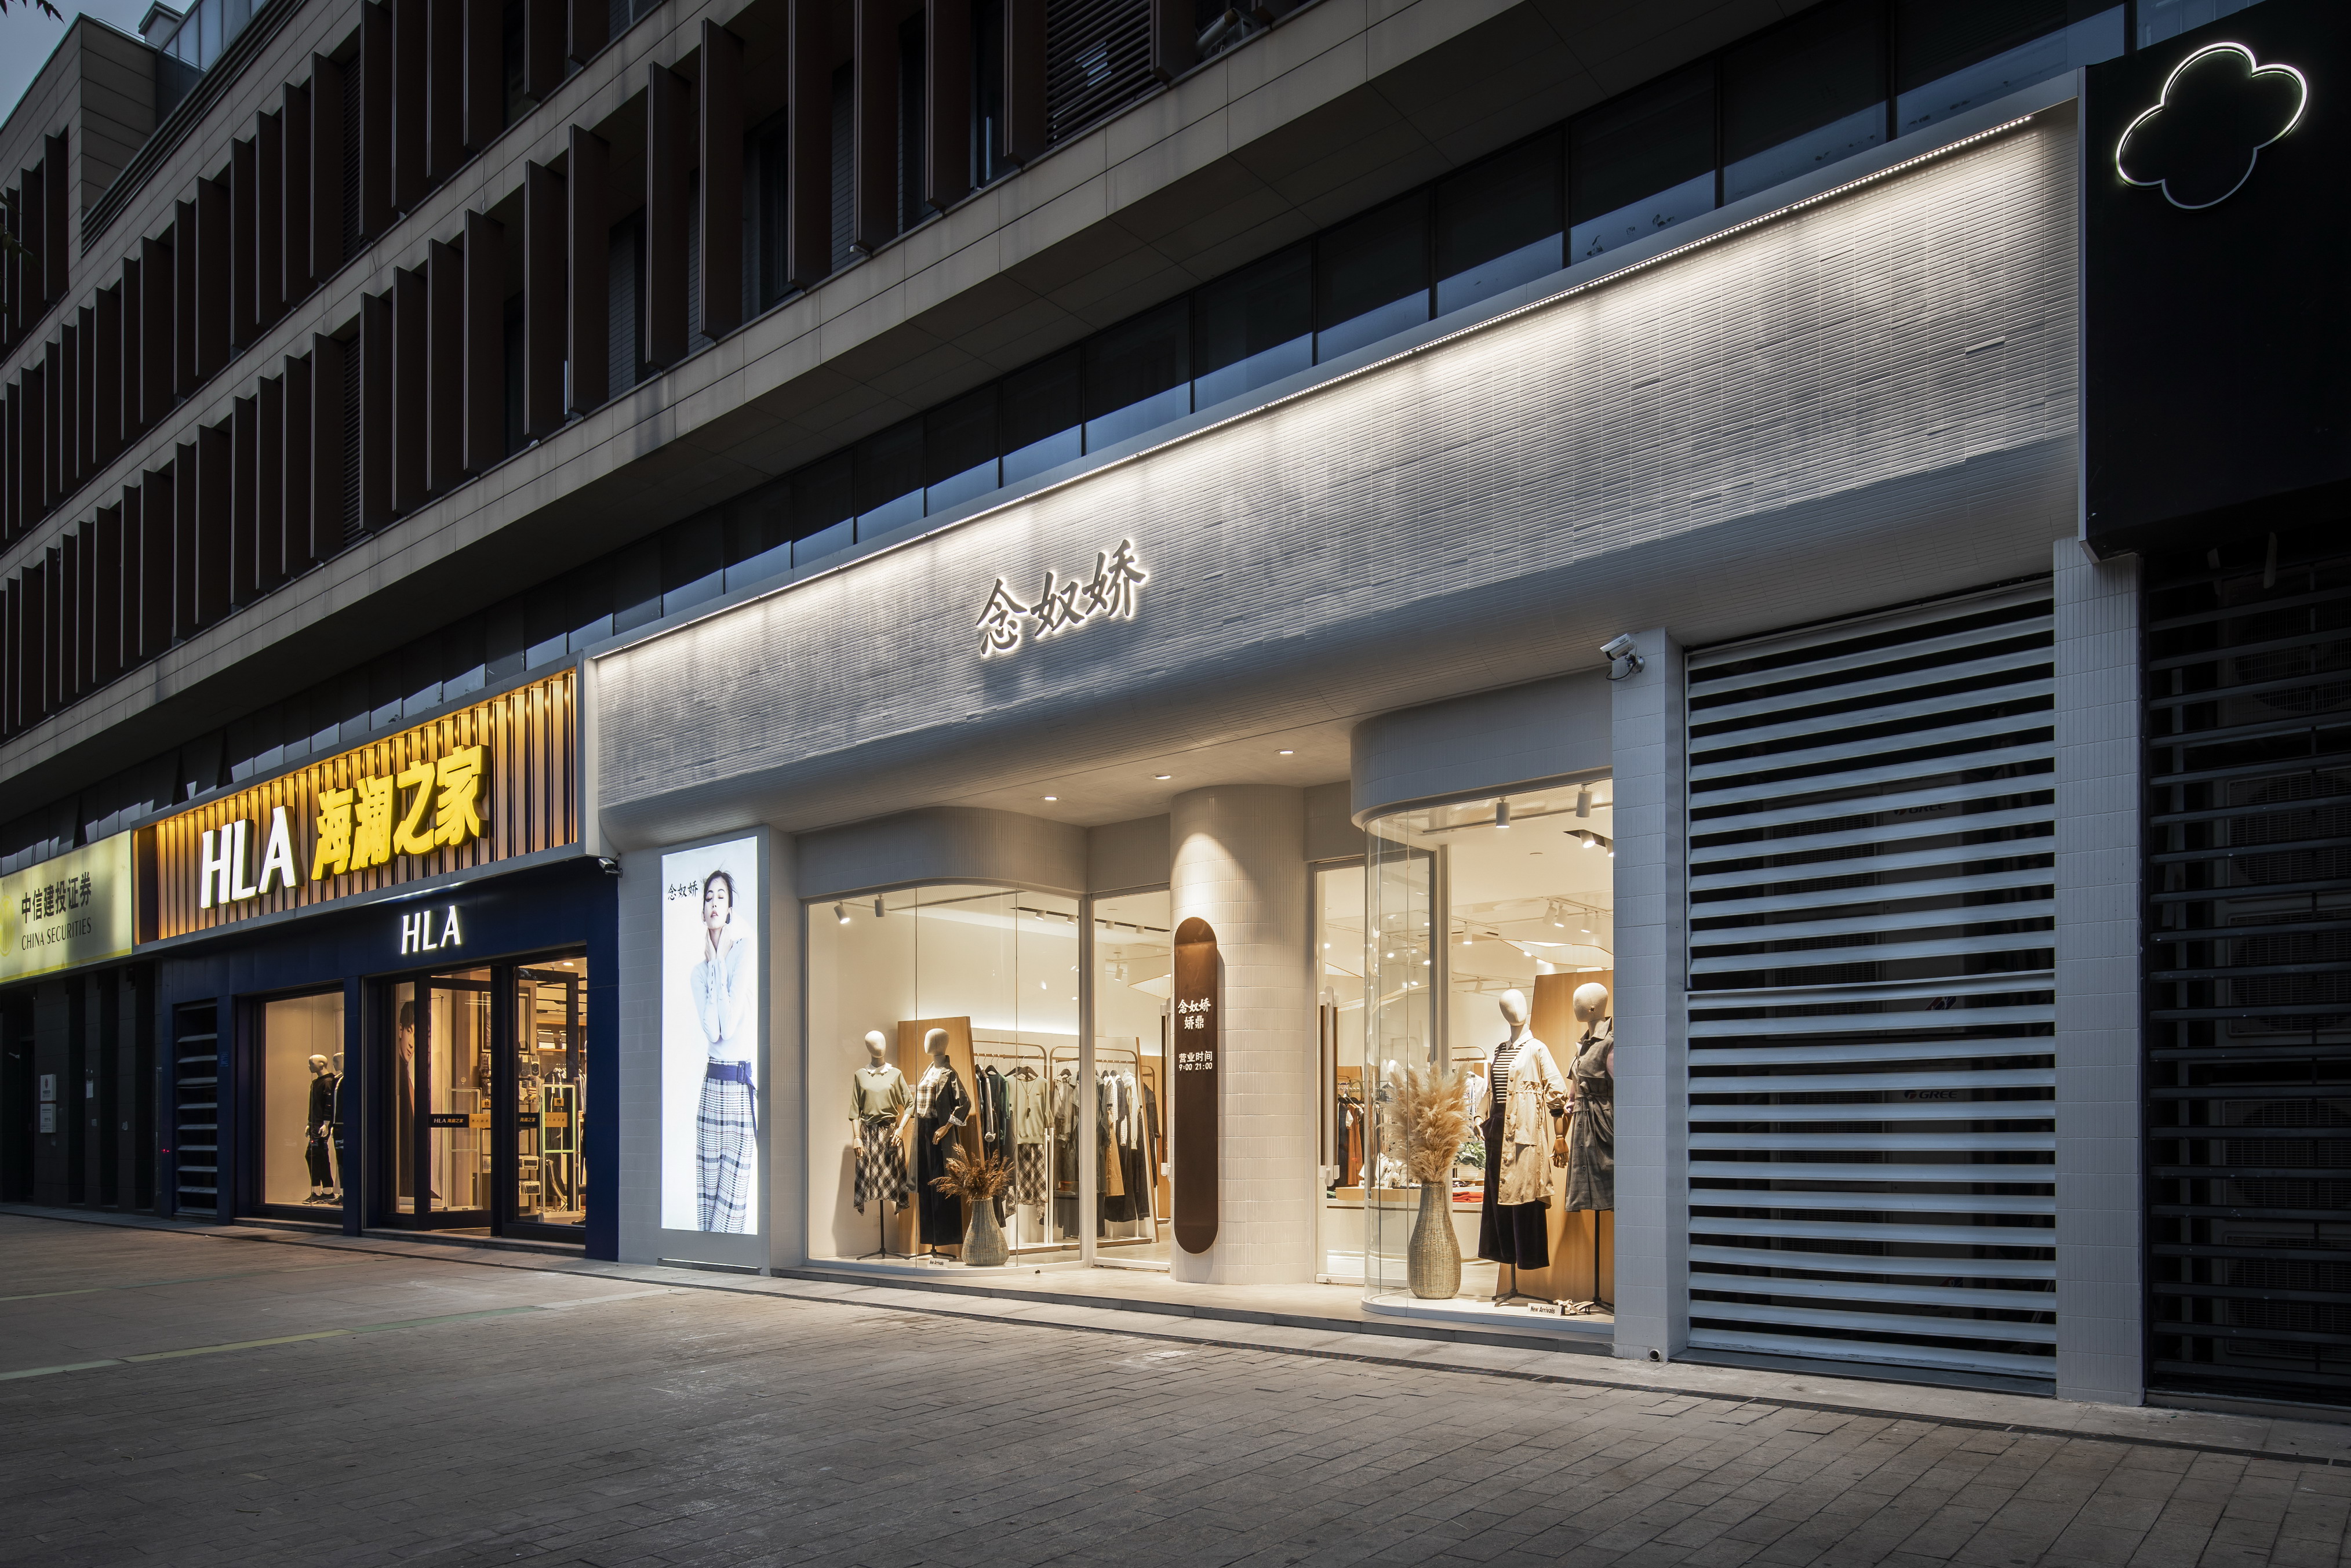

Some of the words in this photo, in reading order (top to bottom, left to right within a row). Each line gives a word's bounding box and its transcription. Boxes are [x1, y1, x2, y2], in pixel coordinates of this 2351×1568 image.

[976, 539, 1147, 655] 念奴娇
[201, 805, 301, 909] HLA
[311, 744, 490, 881] 海澜之家
[21, 871, 92, 924] 中信建投证券
[667, 880, 698, 901] 念奴娇
[21, 930, 45, 951] CHINA
[47, 917, 92, 944] SECURITIES
[401, 905, 461, 955] HLA
[1177, 997, 1211, 1014] 念奴娇
[1184, 1015, 1204, 1029] 娇鼎
[1178, 1050, 1213, 1063] 营业时间
[1178, 1063, 1193, 1071] 9:00
[1195, 1062, 1213, 1071] 21:00
[1919, 1090, 1958, 1099] GREE
[1540, 1306, 1555, 1314] Arrivals
